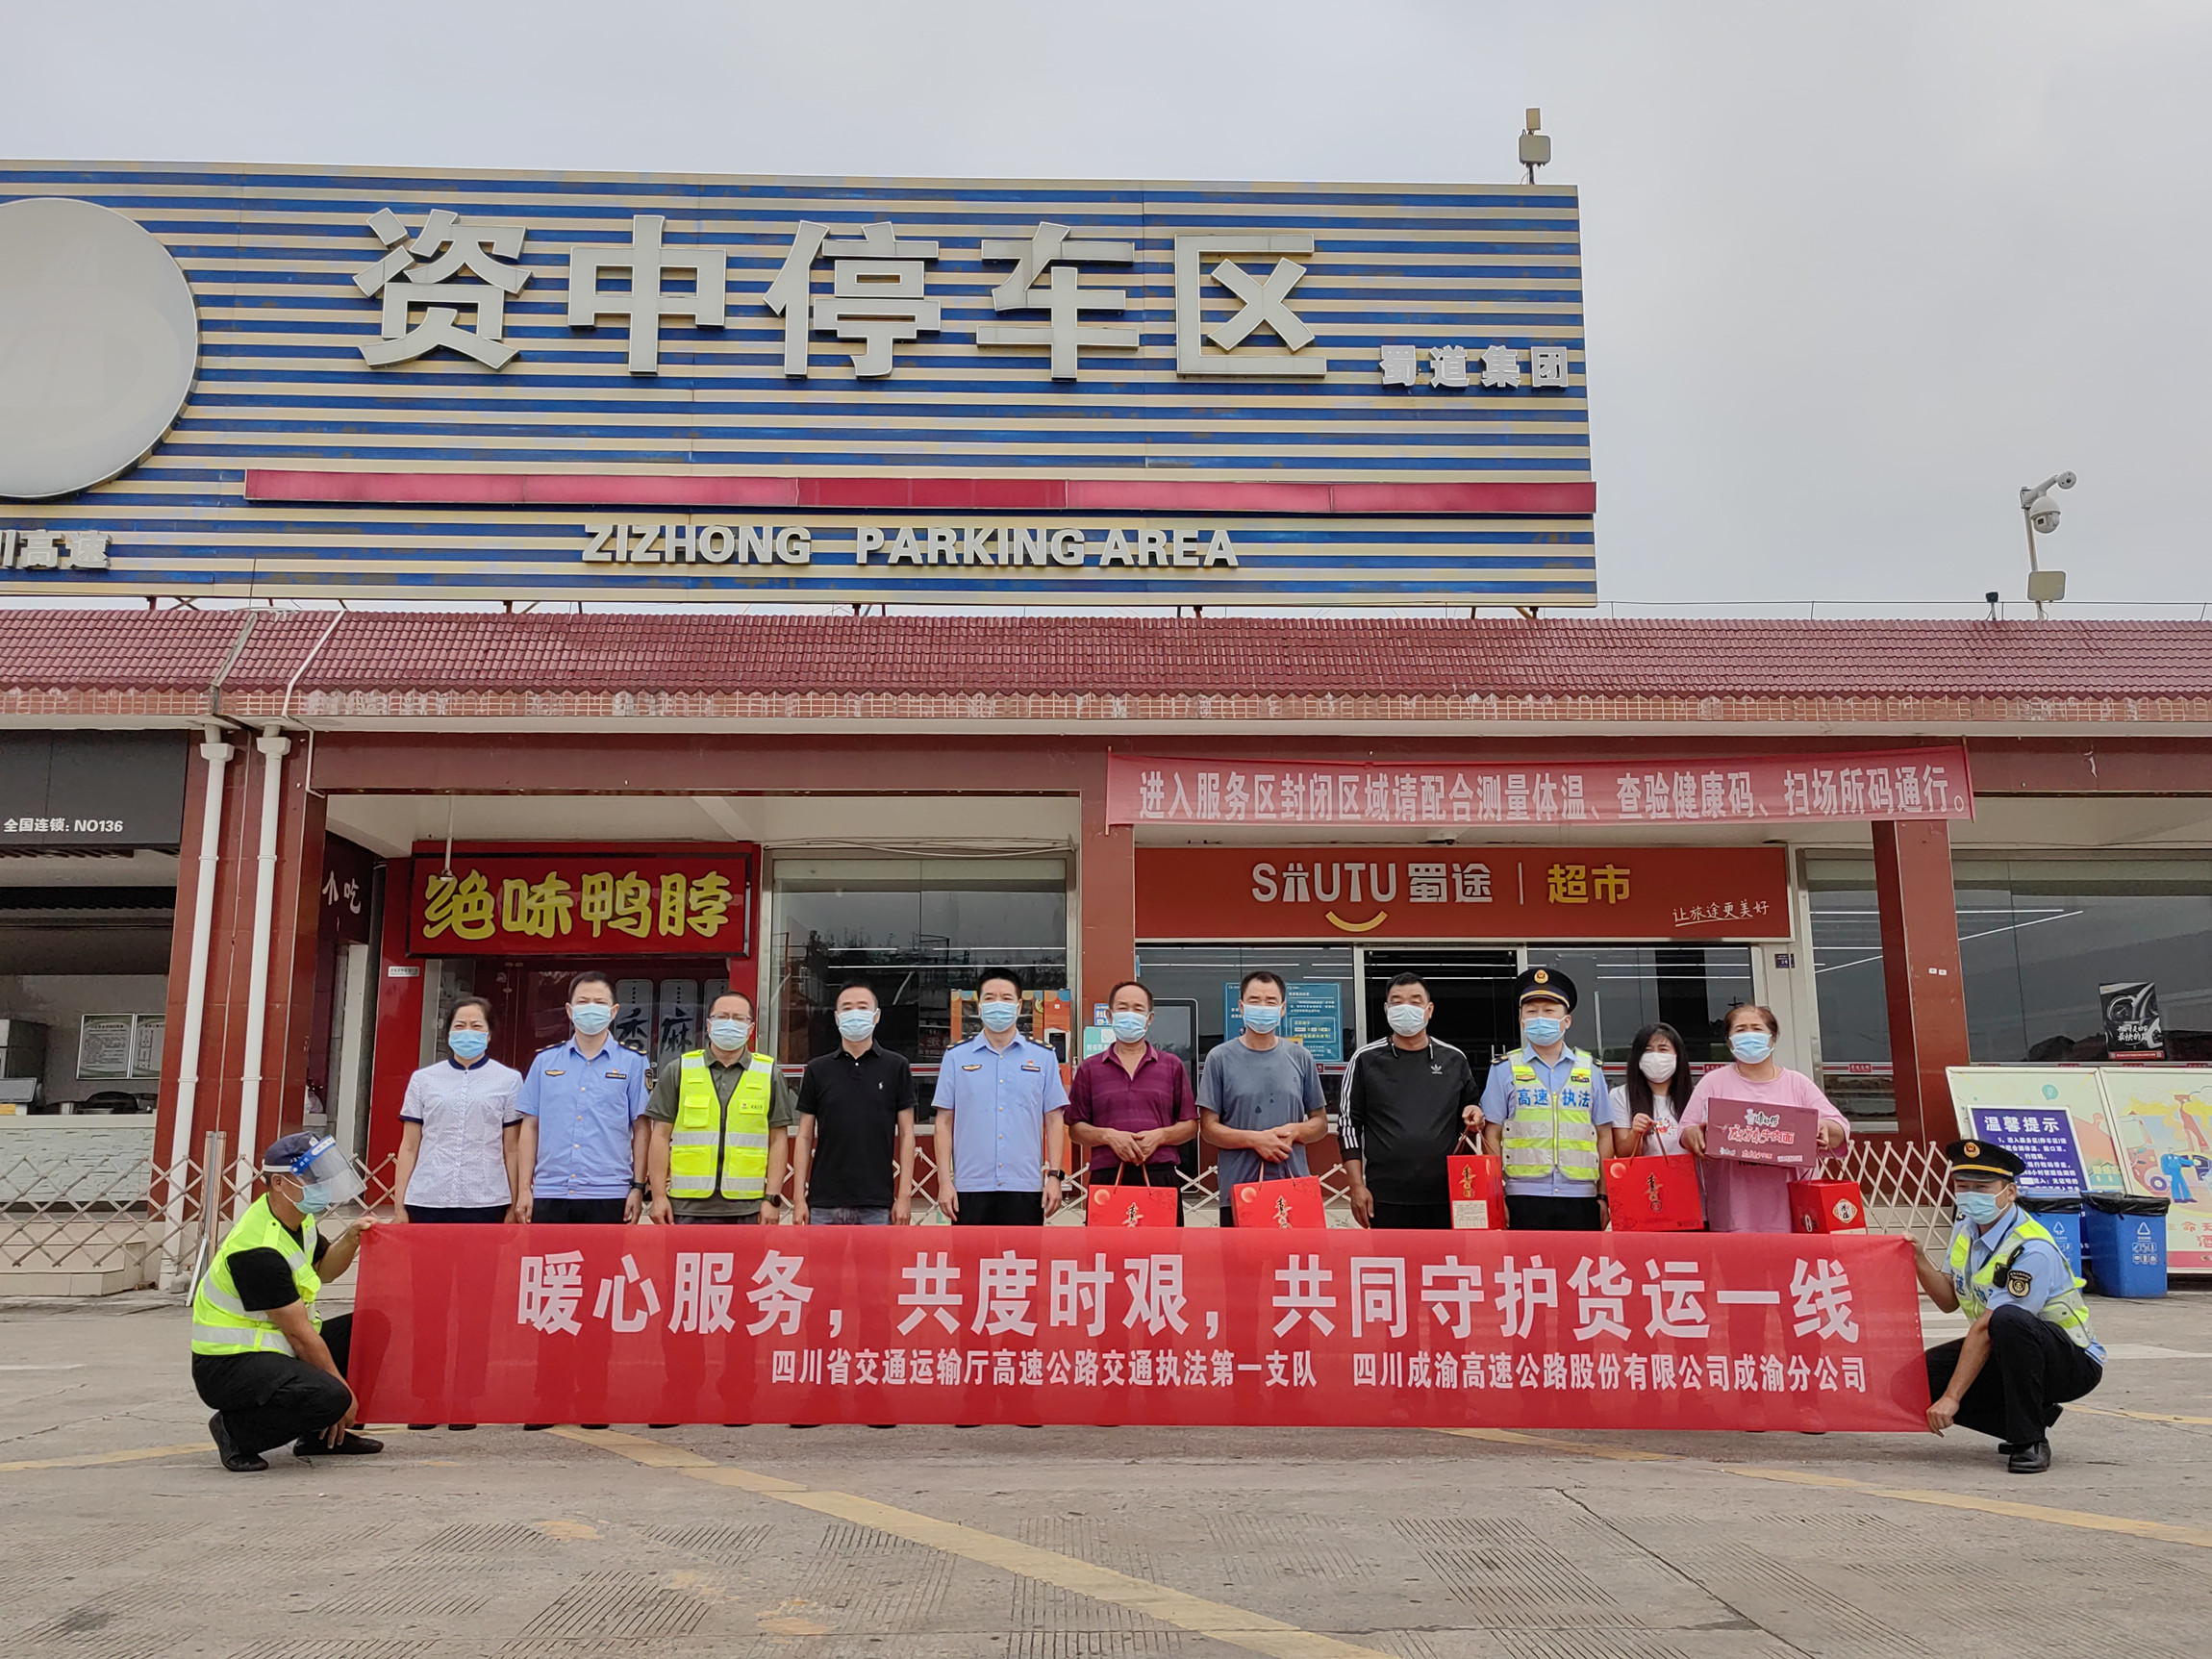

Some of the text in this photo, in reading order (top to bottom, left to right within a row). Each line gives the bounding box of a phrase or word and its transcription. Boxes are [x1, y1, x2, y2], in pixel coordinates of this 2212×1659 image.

[352, 207, 1327, 382] 资中停车区
[1379, 344, 1569, 388] 蜀道集团
[581, 524, 1239, 567] ZIZHONG PARKING AREA
[423, 868, 733, 940] 绝味鸭脖
[1408, 862, 1493, 904] 蜀途
[1546, 863, 1631, 905] 超市
[1672, 898, 1770, 923] 让旅途更美好
[1517, 1088, 1590, 1108] 高速 执法
[1984, 1116, 2059, 1133] 温馨提示
[772, 1347, 1866, 1394] 四川省交通运输厅高速公路交通执法第一支队 四川成渝高速公路股份有限公司成渝分公司
